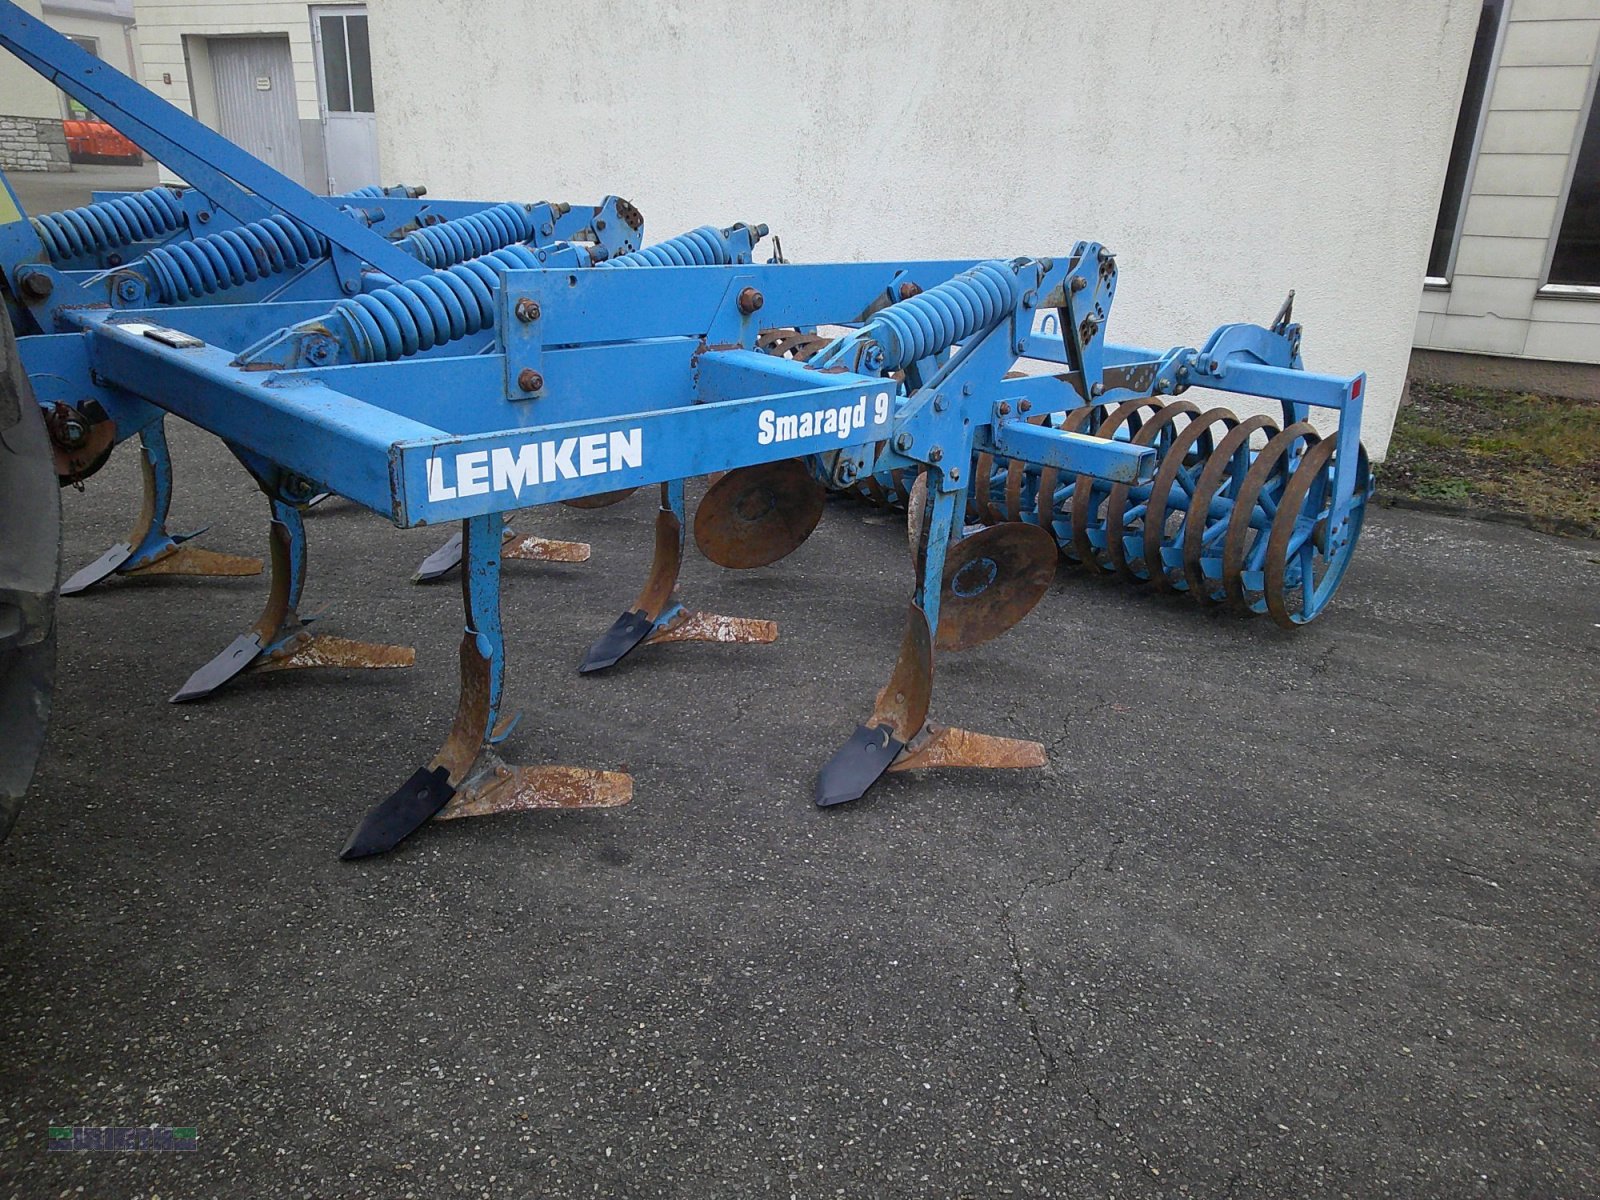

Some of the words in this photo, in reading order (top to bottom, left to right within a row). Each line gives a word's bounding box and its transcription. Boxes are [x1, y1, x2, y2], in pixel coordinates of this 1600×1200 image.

[757, 395, 867, 445] Smaragd
[873, 392, 889, 425] 9
[426, 428, 642, 503] LEMKEN
